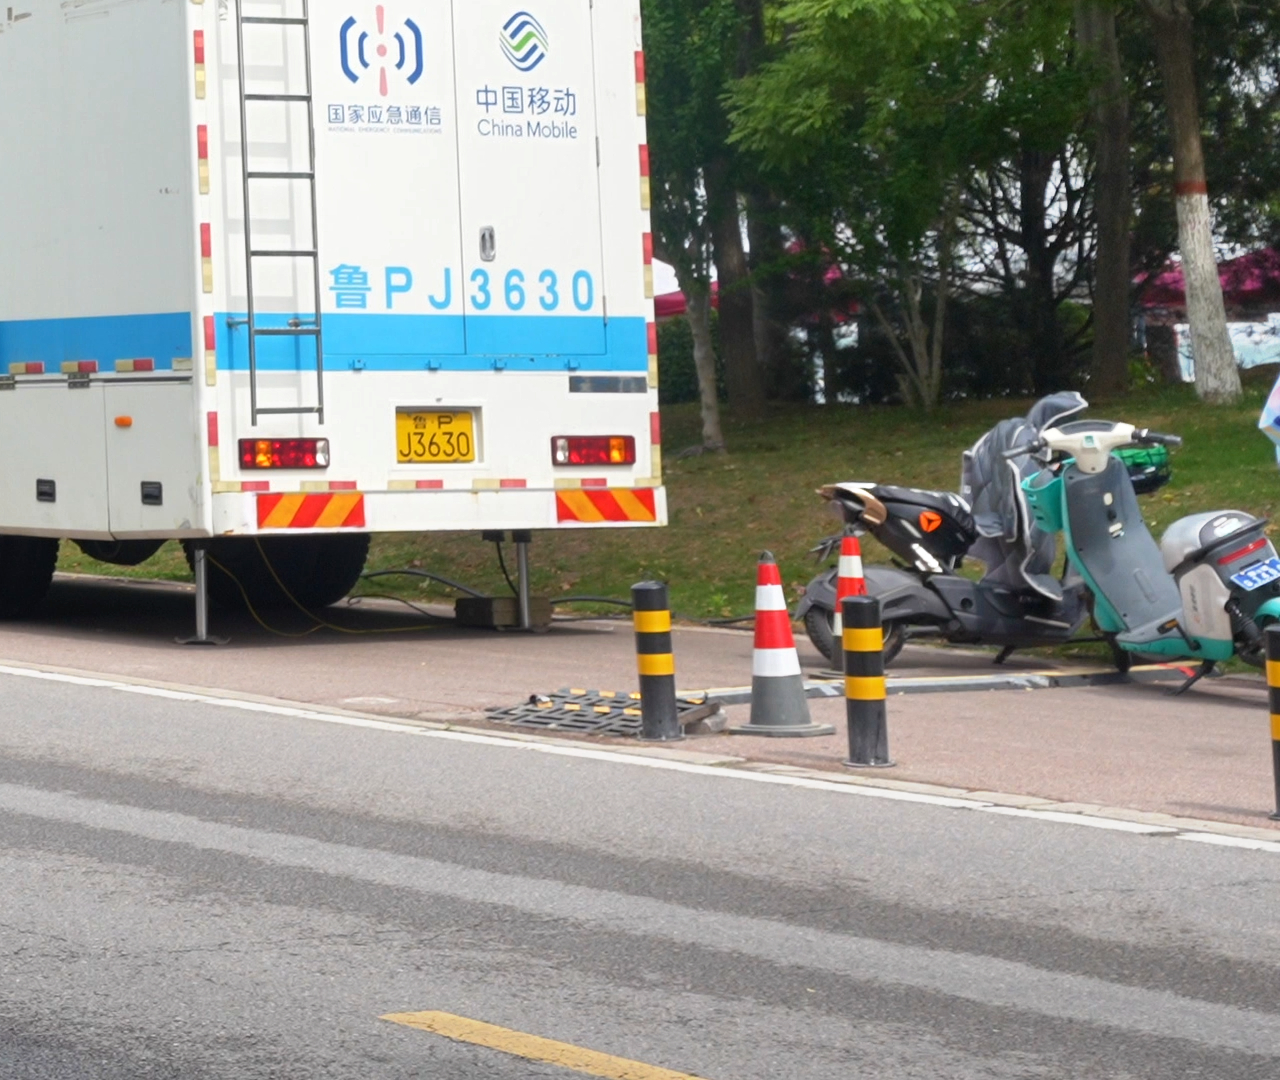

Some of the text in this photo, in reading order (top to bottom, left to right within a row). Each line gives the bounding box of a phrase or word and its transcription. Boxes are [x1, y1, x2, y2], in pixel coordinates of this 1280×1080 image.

[476, 84, 576, 117] 中国移动
[327, 103, 441, 126] 国家应急通信
[477, 118, 578, 139] China Mobile
[329, 263, 594, 312] 鲁PJ3630
[399, 431, 470, 457] J3630
